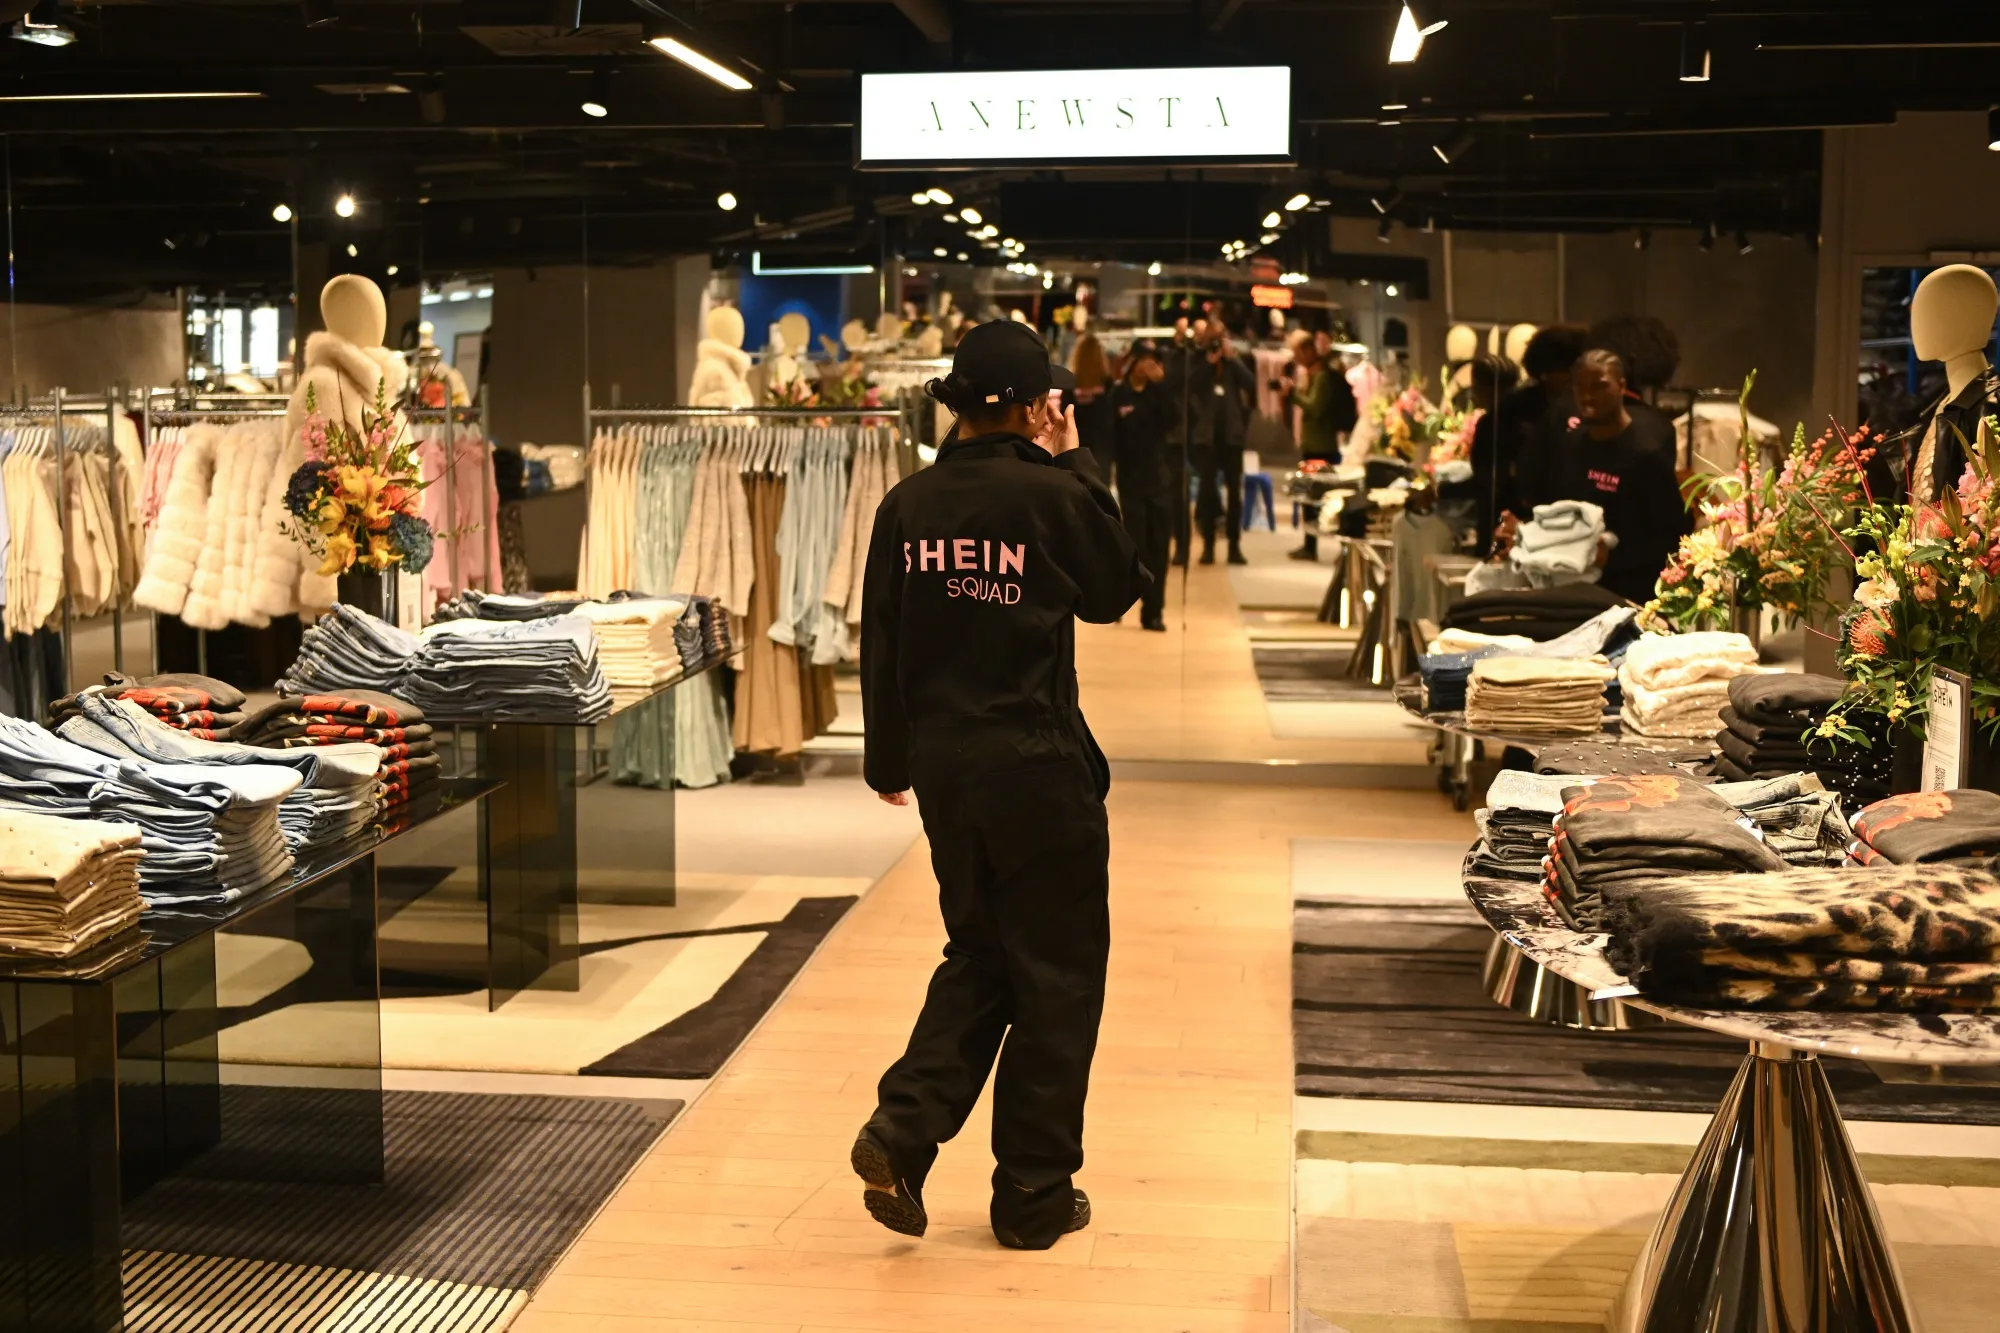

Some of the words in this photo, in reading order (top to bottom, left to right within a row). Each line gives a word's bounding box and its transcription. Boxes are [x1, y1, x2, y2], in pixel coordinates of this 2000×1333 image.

[921, 96, 1230, 131] ANEWSTA
[947, 577, 1021, 605] SQUAD
[1933, 689, 1953, 708] SHEIN
